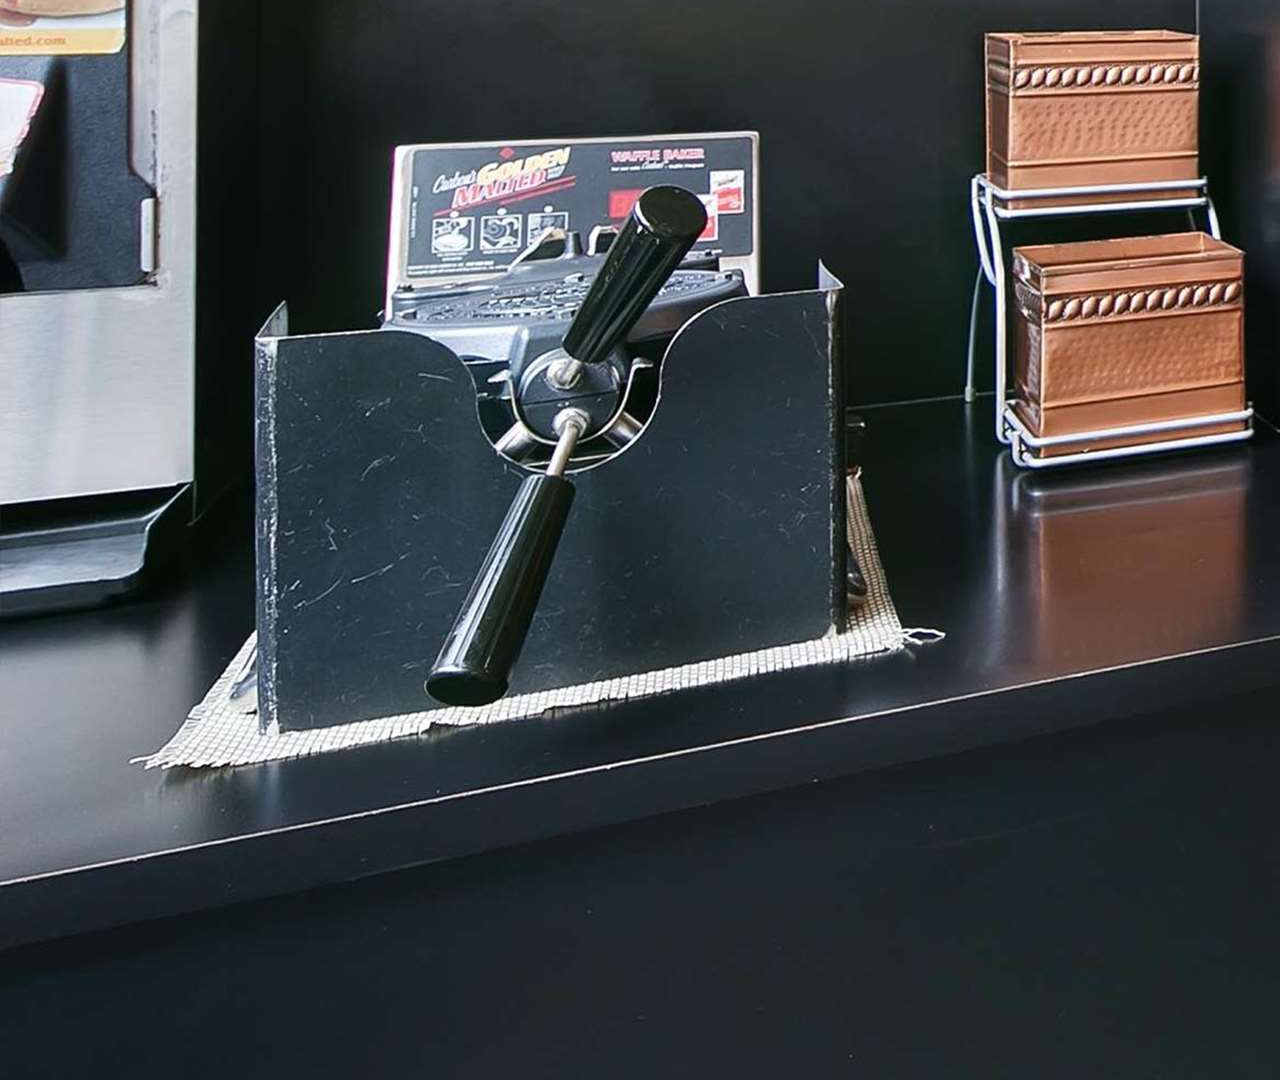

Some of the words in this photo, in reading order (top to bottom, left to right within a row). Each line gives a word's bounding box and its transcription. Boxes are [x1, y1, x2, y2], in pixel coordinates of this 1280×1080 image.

[476, 146, 571, 185] GOLDEN
[610, 149, 661, 163] WAFFLE
[663, 148, 705, 160] BAKER
[451, 169, 547, 209] MALTED
